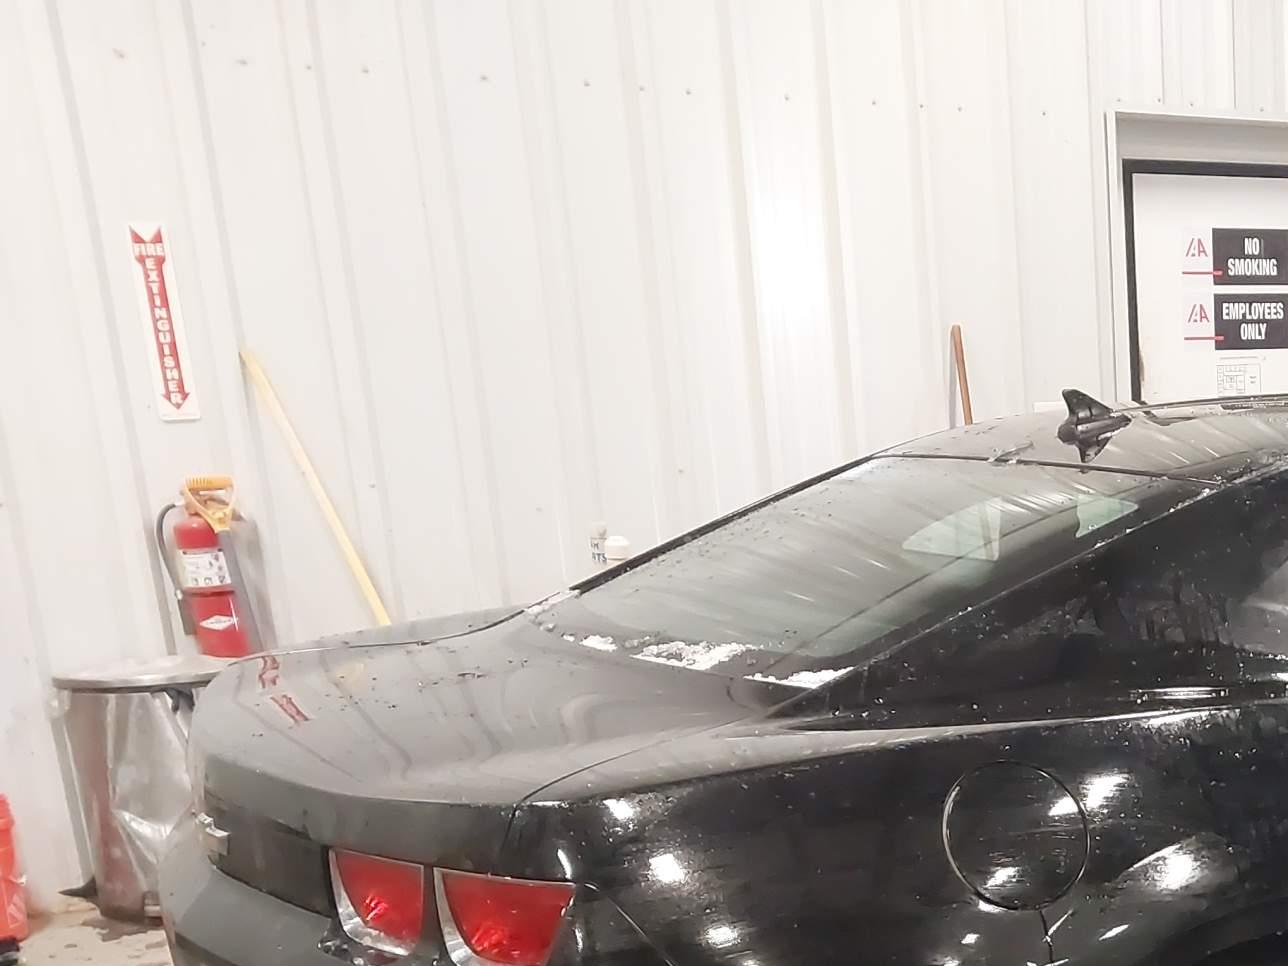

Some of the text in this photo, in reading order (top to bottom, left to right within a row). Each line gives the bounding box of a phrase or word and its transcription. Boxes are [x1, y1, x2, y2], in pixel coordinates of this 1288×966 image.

[134, 243, 165, 256] FIRE
[1244, 237, 1260, 255] NO
[1227, 258, 1278, 276] SMOKING
[1222, 302, 1284, 320] EMPLOYEES
[145, 257, 185, 405] EXTINGUISHER
[1240, 322, 1267, 340] ONLY
